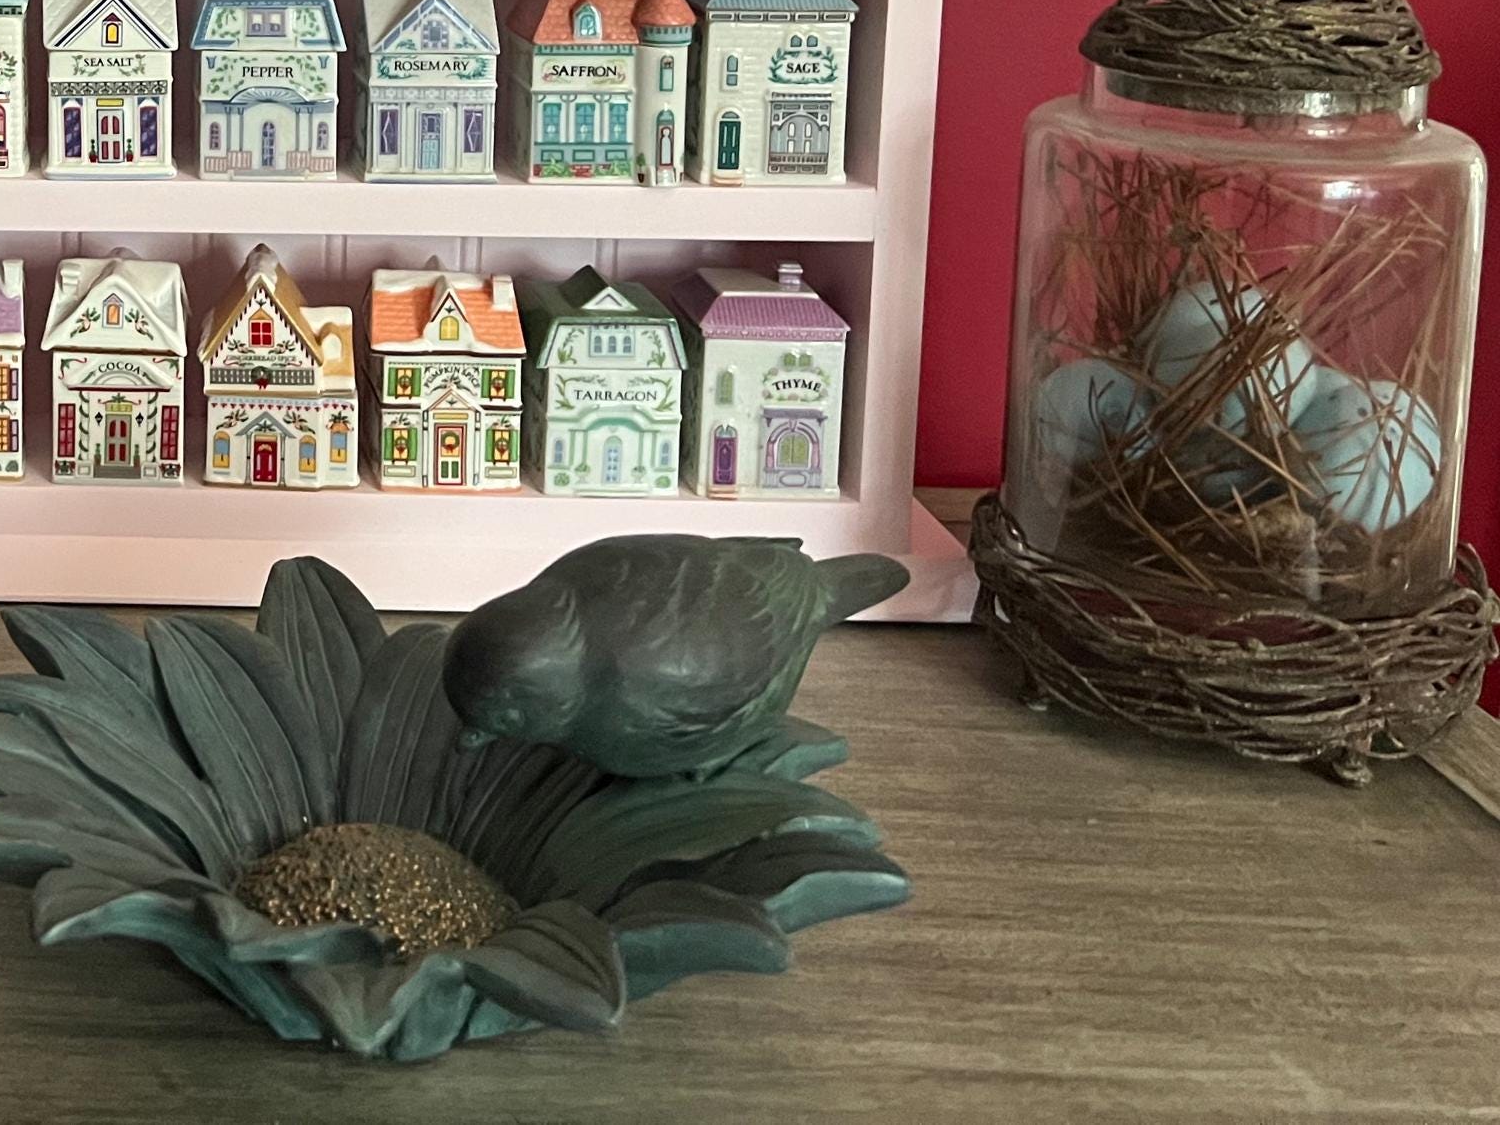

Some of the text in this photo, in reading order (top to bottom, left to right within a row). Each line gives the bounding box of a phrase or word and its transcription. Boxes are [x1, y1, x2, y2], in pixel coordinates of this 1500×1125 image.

[83, 57, 134, 67] SEA SALT
[394, 60, 469, 72] ROSEMARY
[785, 62, 821, 74] SAGE
[242, 66, 294, 78] PEPPER
[549, 64, 617, 77] SAFFRON
[98, 361, 140, 375] COCOA
[423, 366, 460, 388] PUMPKIN
[771, 378, 822, 392] THYME
[574, 389, 657, 401] TARRAGON
